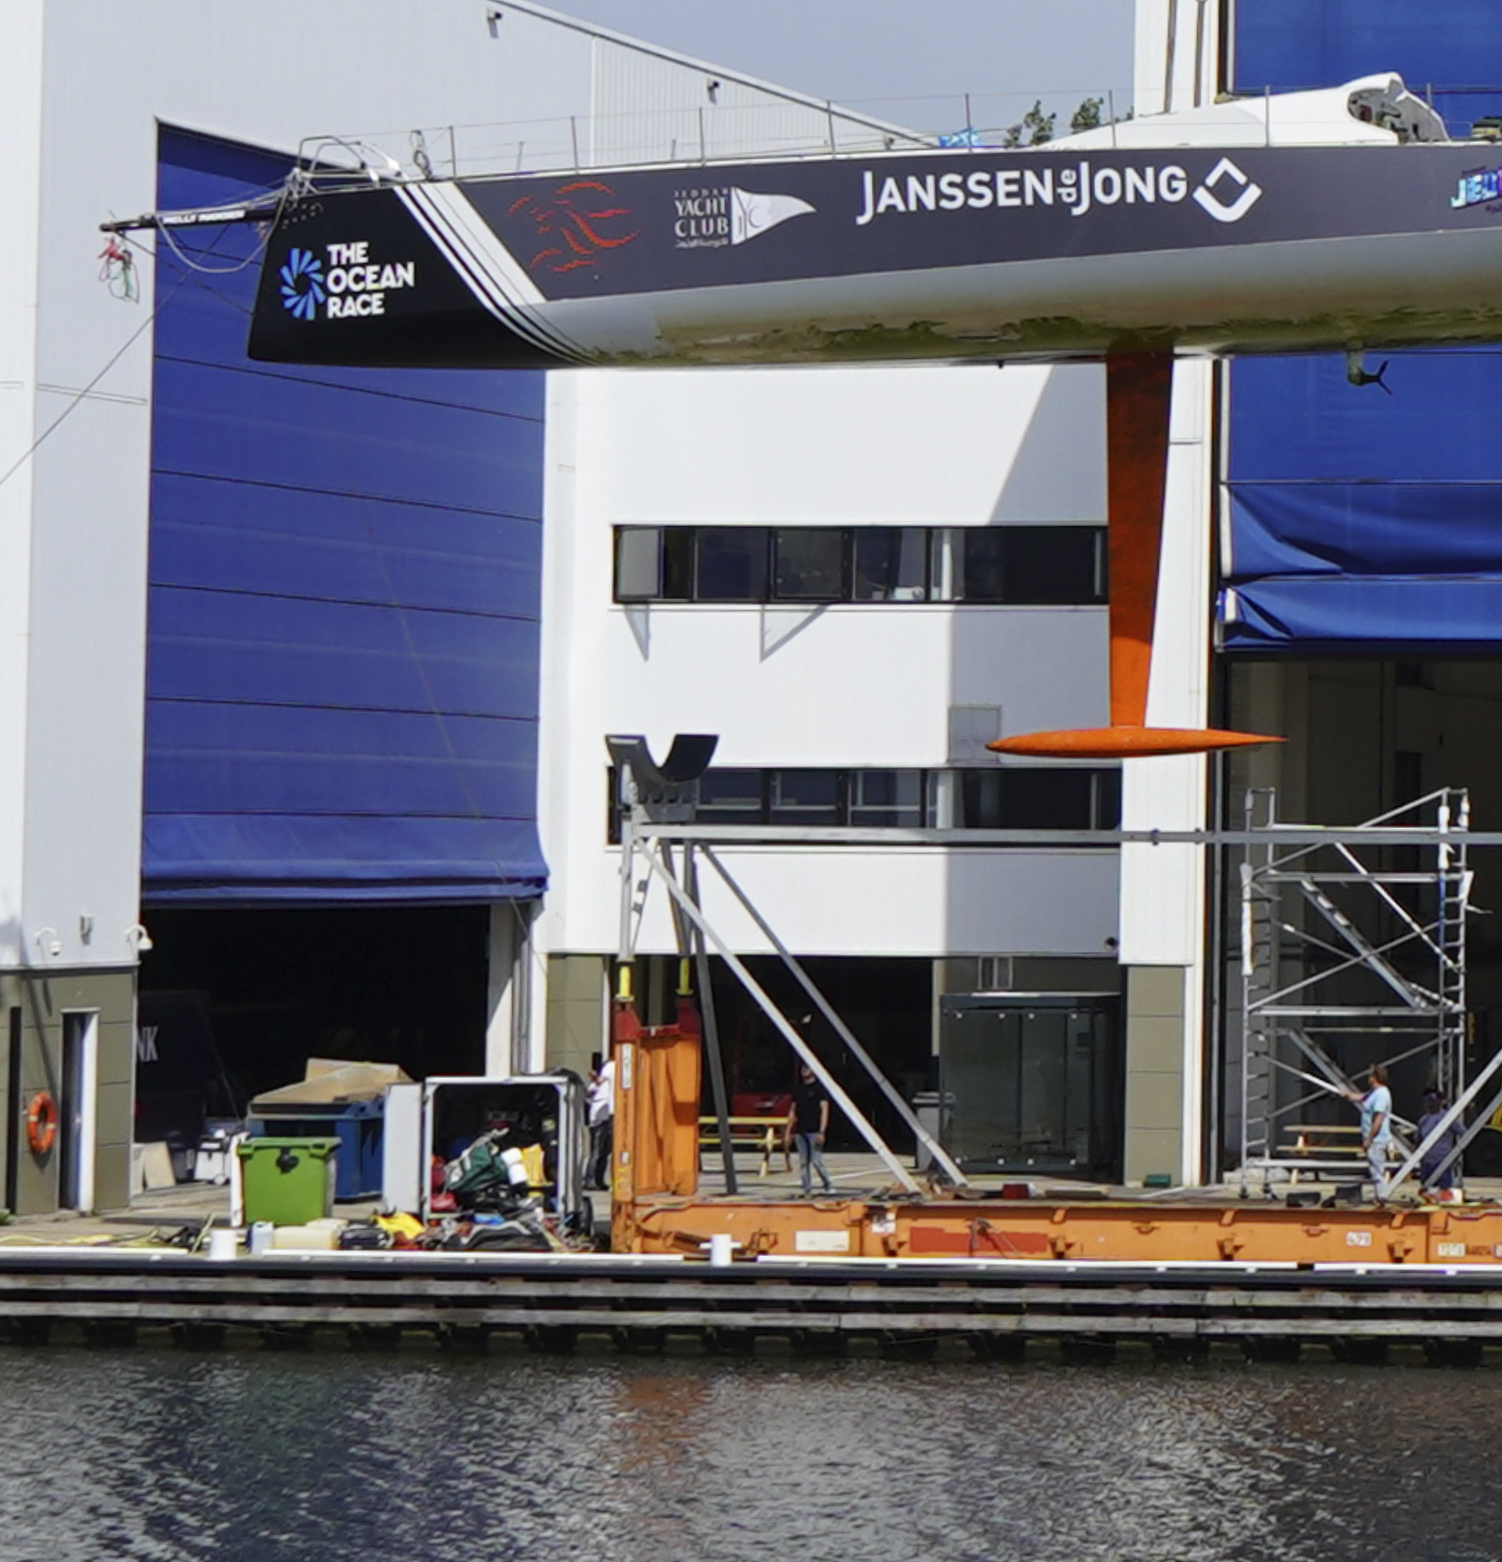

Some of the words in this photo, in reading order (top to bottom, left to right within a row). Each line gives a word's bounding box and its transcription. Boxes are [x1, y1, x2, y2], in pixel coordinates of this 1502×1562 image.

[674, 196, 727, 217] YACHT
[855, 168, 1054, 226] JANSSEN
[1070, 162, 1188, 216] JONG
[674, 216, 730, 238] CLUB
[326, 241, 369, 266] THE
[326, 261, 416, 294] OCEAN
[326, 292, 385, 319] RACE
